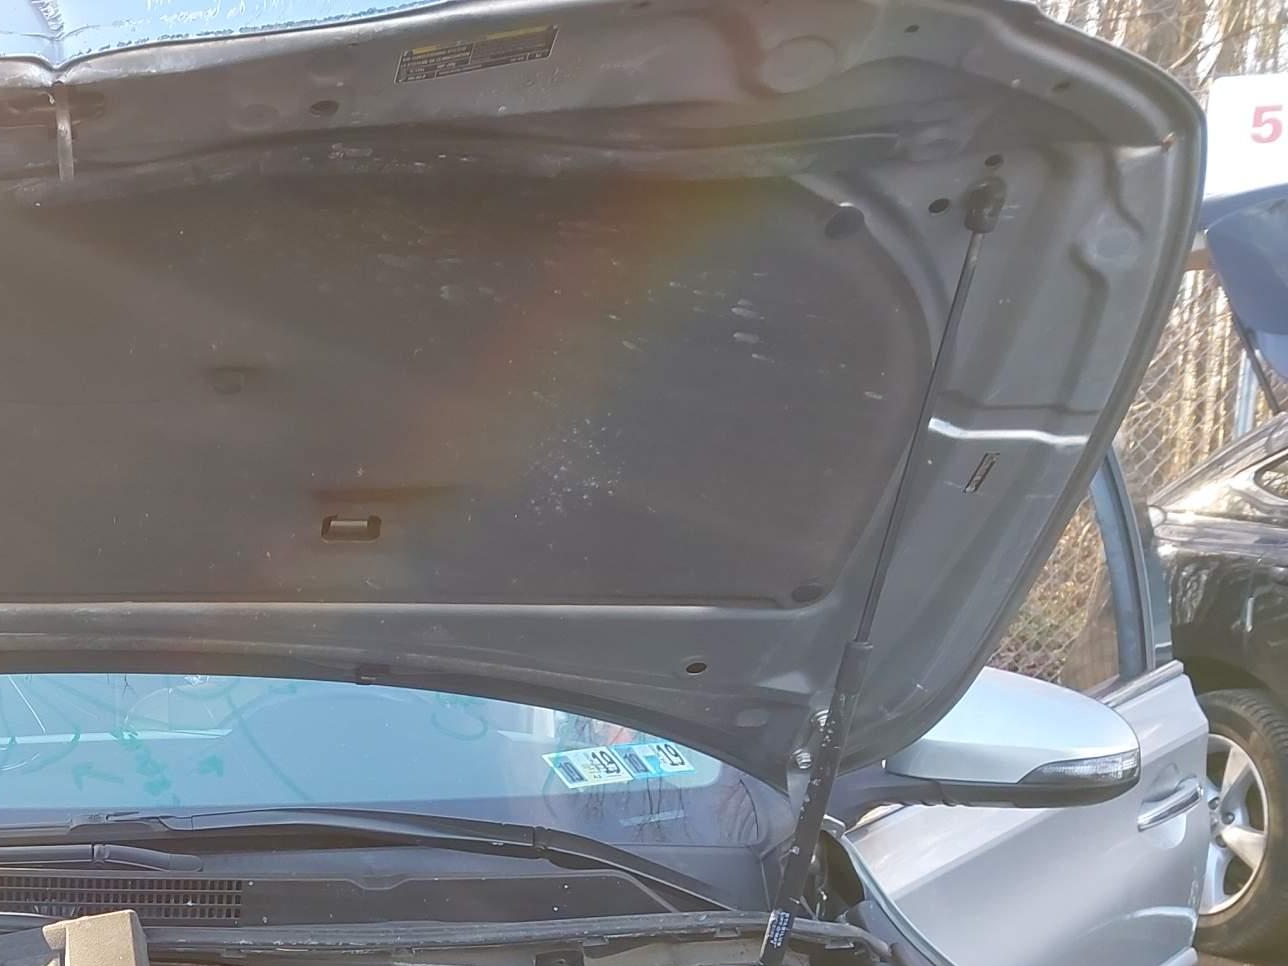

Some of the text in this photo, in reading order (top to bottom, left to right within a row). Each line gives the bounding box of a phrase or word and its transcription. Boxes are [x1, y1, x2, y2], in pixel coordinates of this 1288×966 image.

[1251, 105, 1283, 143] 5
[591, 750, 621, 775] 19
[656, 743, 686, 766] 19
